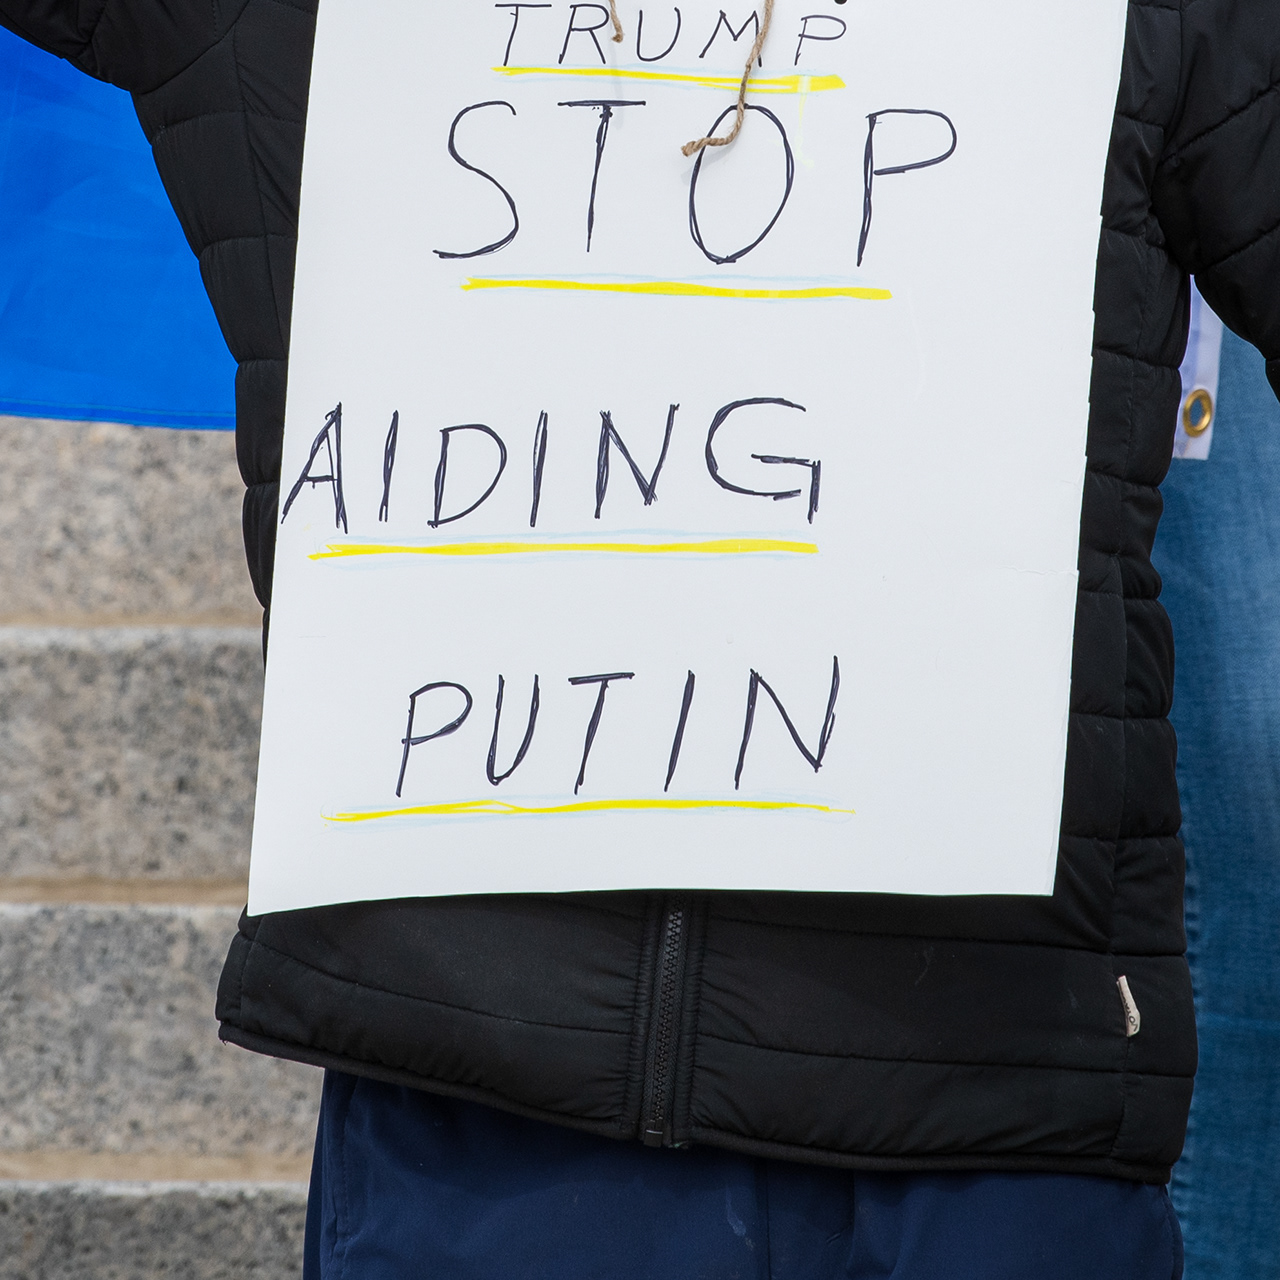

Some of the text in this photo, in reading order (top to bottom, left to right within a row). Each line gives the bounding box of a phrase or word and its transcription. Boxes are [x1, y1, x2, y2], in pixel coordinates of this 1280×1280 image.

[494, 2, 848, 67] TRUMP
[433, 99, 958, 267] STOP
[281, 396, 821, 534] AIDING
[394, 655, 840, 798] PUTIN
